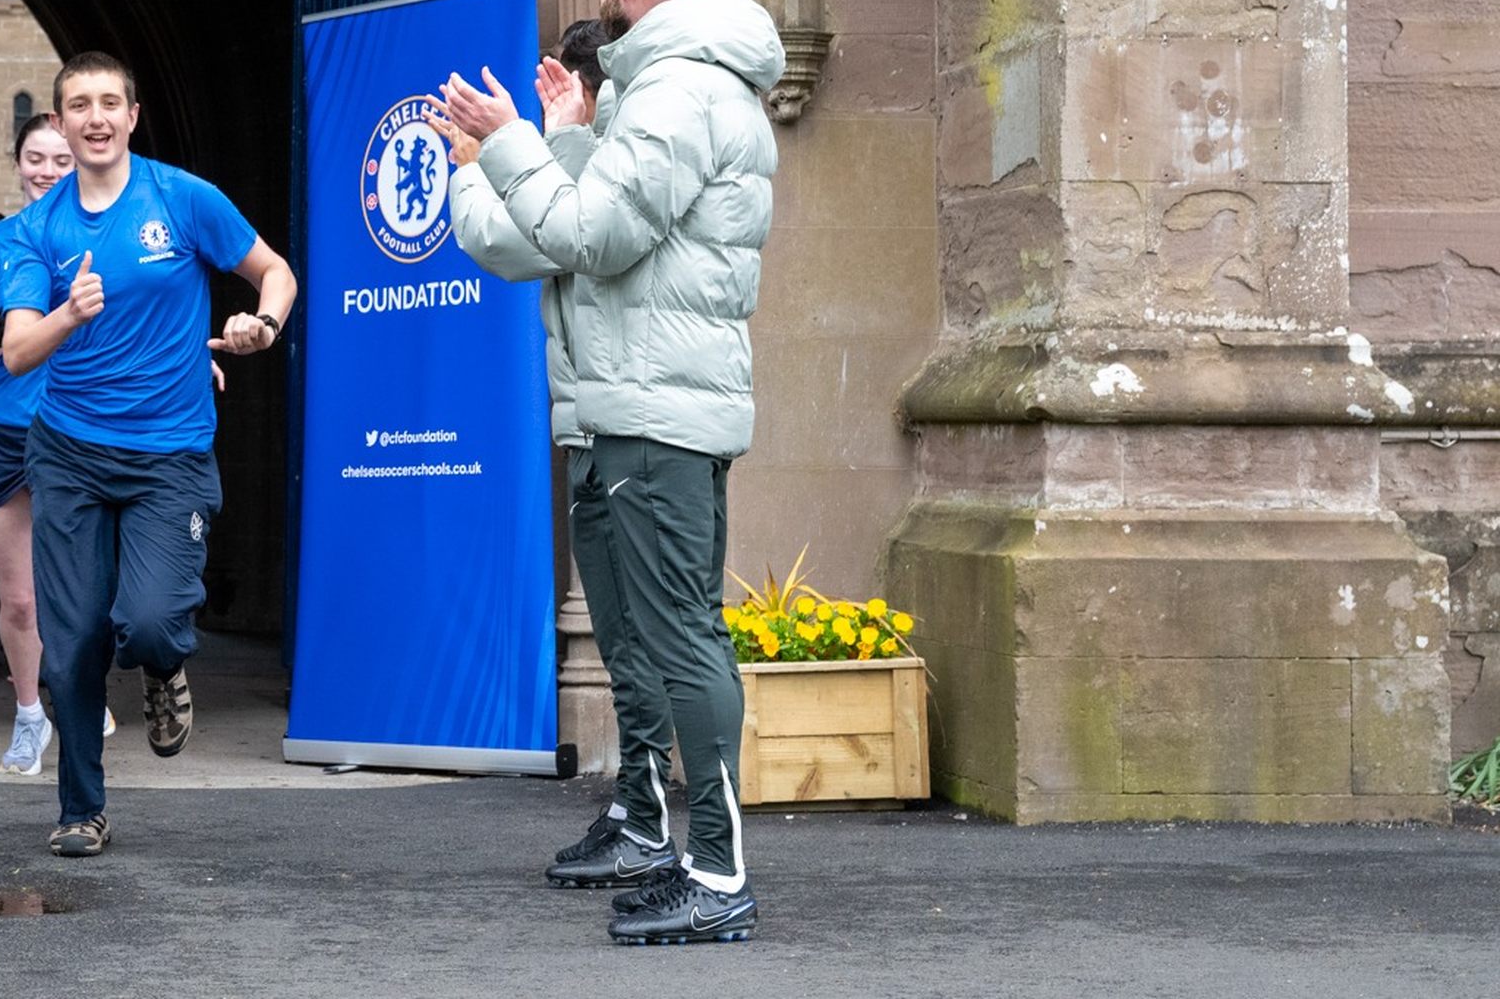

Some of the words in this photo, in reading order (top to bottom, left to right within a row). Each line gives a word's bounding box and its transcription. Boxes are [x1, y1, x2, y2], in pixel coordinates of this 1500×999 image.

[378, 226, 422, 253] FOOTBALL
[424, 218, 446, 247] CLUB
[344, 278, 480, 314] FOUNDATION
[379, 429, 457, 447] @cfcfoundation
[341, 461, 482, 478] chelseasoccerschools.co.uk
